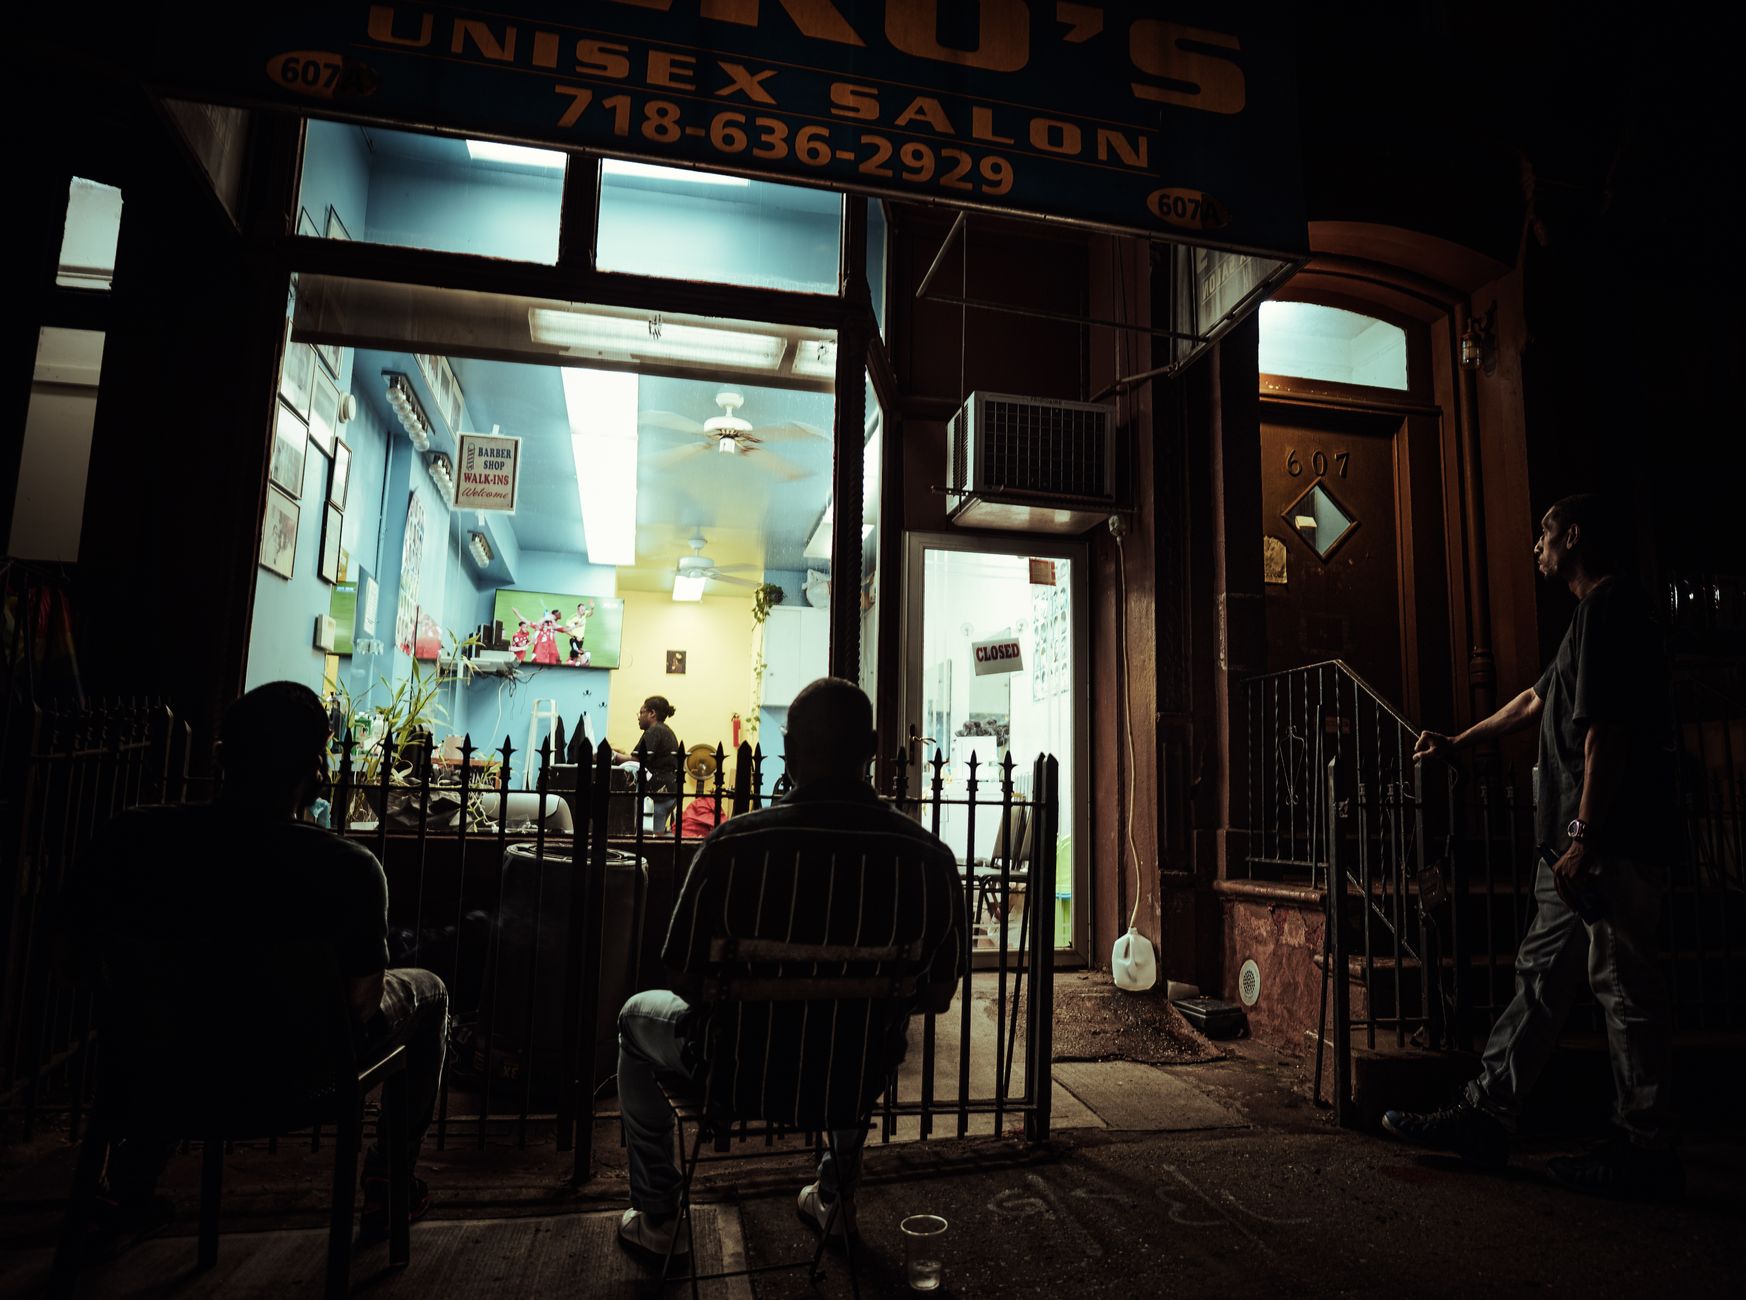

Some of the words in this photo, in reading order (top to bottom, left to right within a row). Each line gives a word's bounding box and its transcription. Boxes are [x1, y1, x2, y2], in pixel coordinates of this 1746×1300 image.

[366, 4, 780, 105] UNISEX
[829, 81, 1149, 169] SALON
[553, 84, 1014, 196] 718-636-2929
[478, 447, 512, 459] BARBER
[483, 460, 505, 471] SHOP
[1285, 449, 1350, 478] 607
[463, 472, 510, 486] WALK-INS
[462, 487, 509, 499] Welcome
[975, 643, 1020, 662] CLOSED
